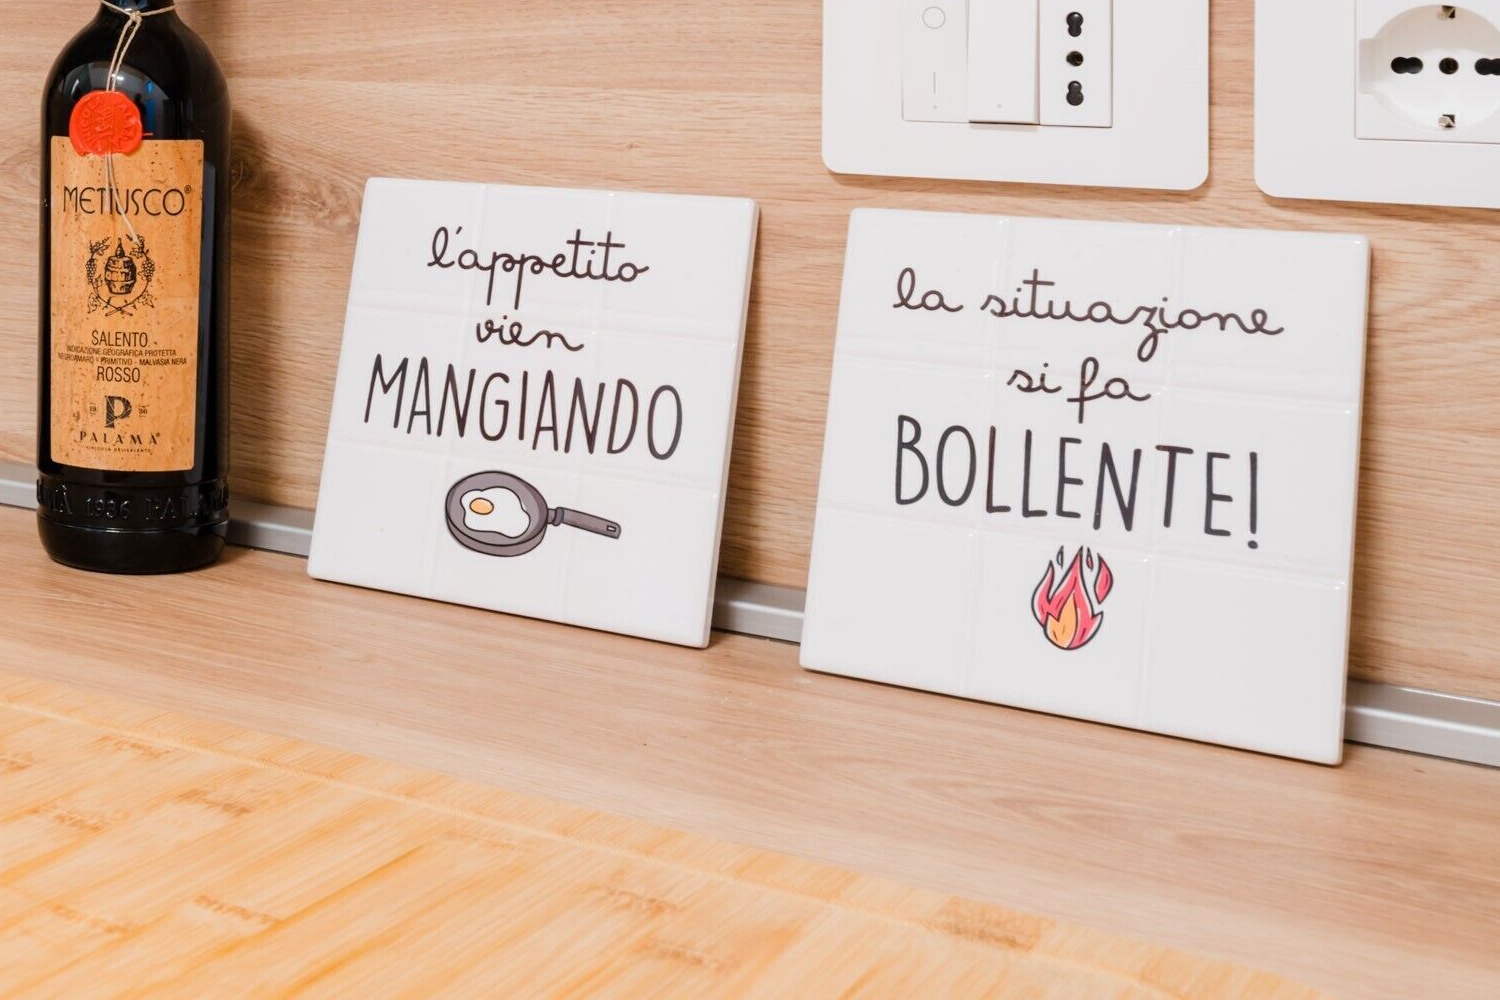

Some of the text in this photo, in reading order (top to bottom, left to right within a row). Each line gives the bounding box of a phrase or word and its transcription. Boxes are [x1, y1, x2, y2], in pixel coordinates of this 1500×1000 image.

[476, 314, 585, 353] vien
[892, 267, 1285, 362] la situazione
[91, 329, 149, 348] SALENTO
[144, 349, 177, 357] PROTETTA
[96, 365, 141, 383] ROSSO
[100, 356, 132, 365] PRIMITIVO
[139, 358, 170, 366] MALVASIA
[171, 357, 187, 365] NERA
[363, 352, 684, 462] MANGIANDO
[1006, 355, 1152, 424] si fa
[894, 414, 1259, 551] BOLLENTE!
